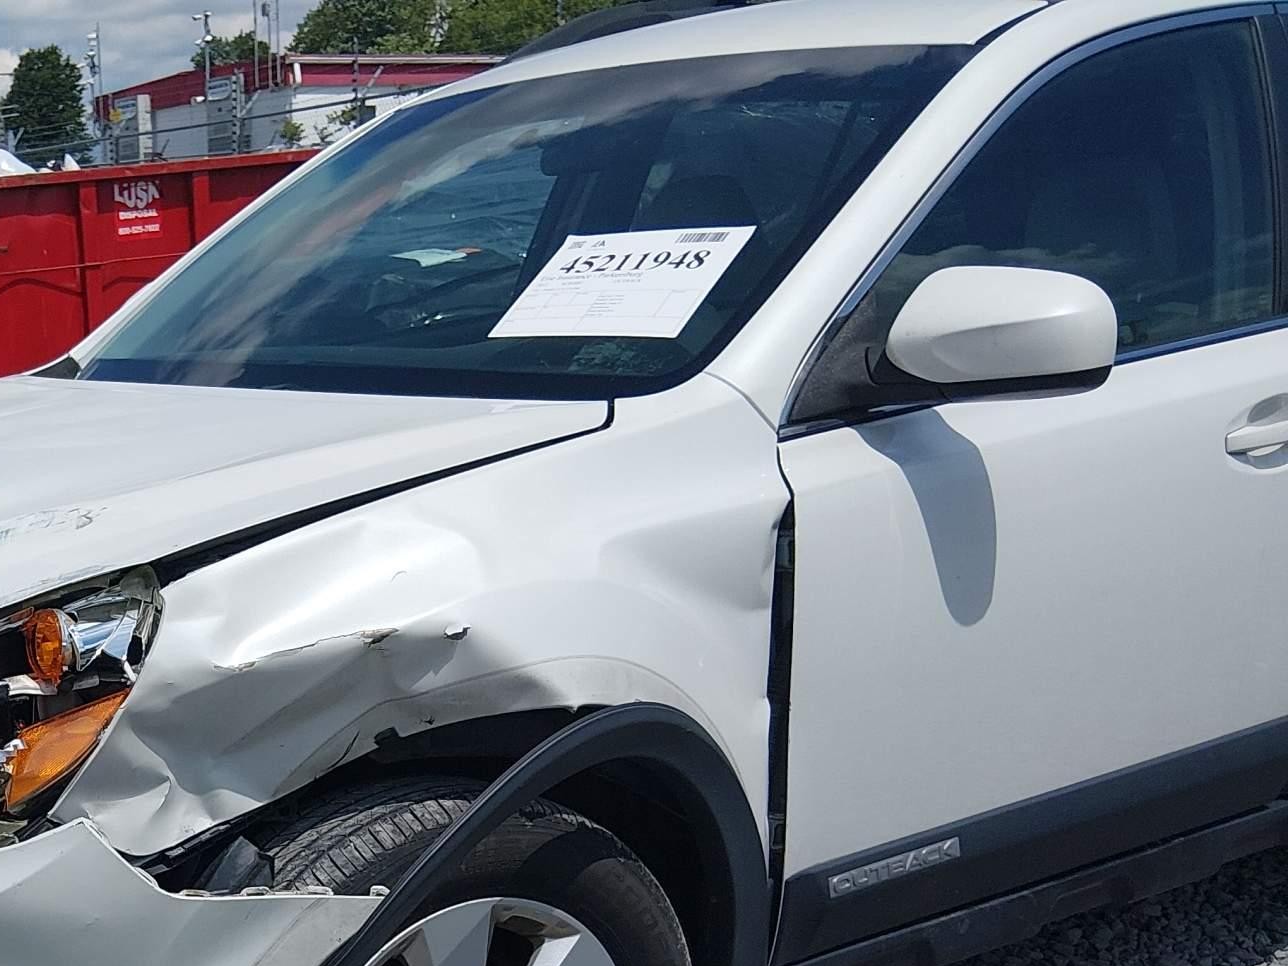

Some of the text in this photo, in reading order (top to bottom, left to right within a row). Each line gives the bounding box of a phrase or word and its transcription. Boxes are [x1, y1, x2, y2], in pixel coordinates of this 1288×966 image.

[113, 180, 160, 209] LUSK
[560, 250, 711, 274] 45211948
[833, 840, 955, 894] OUTBACK
